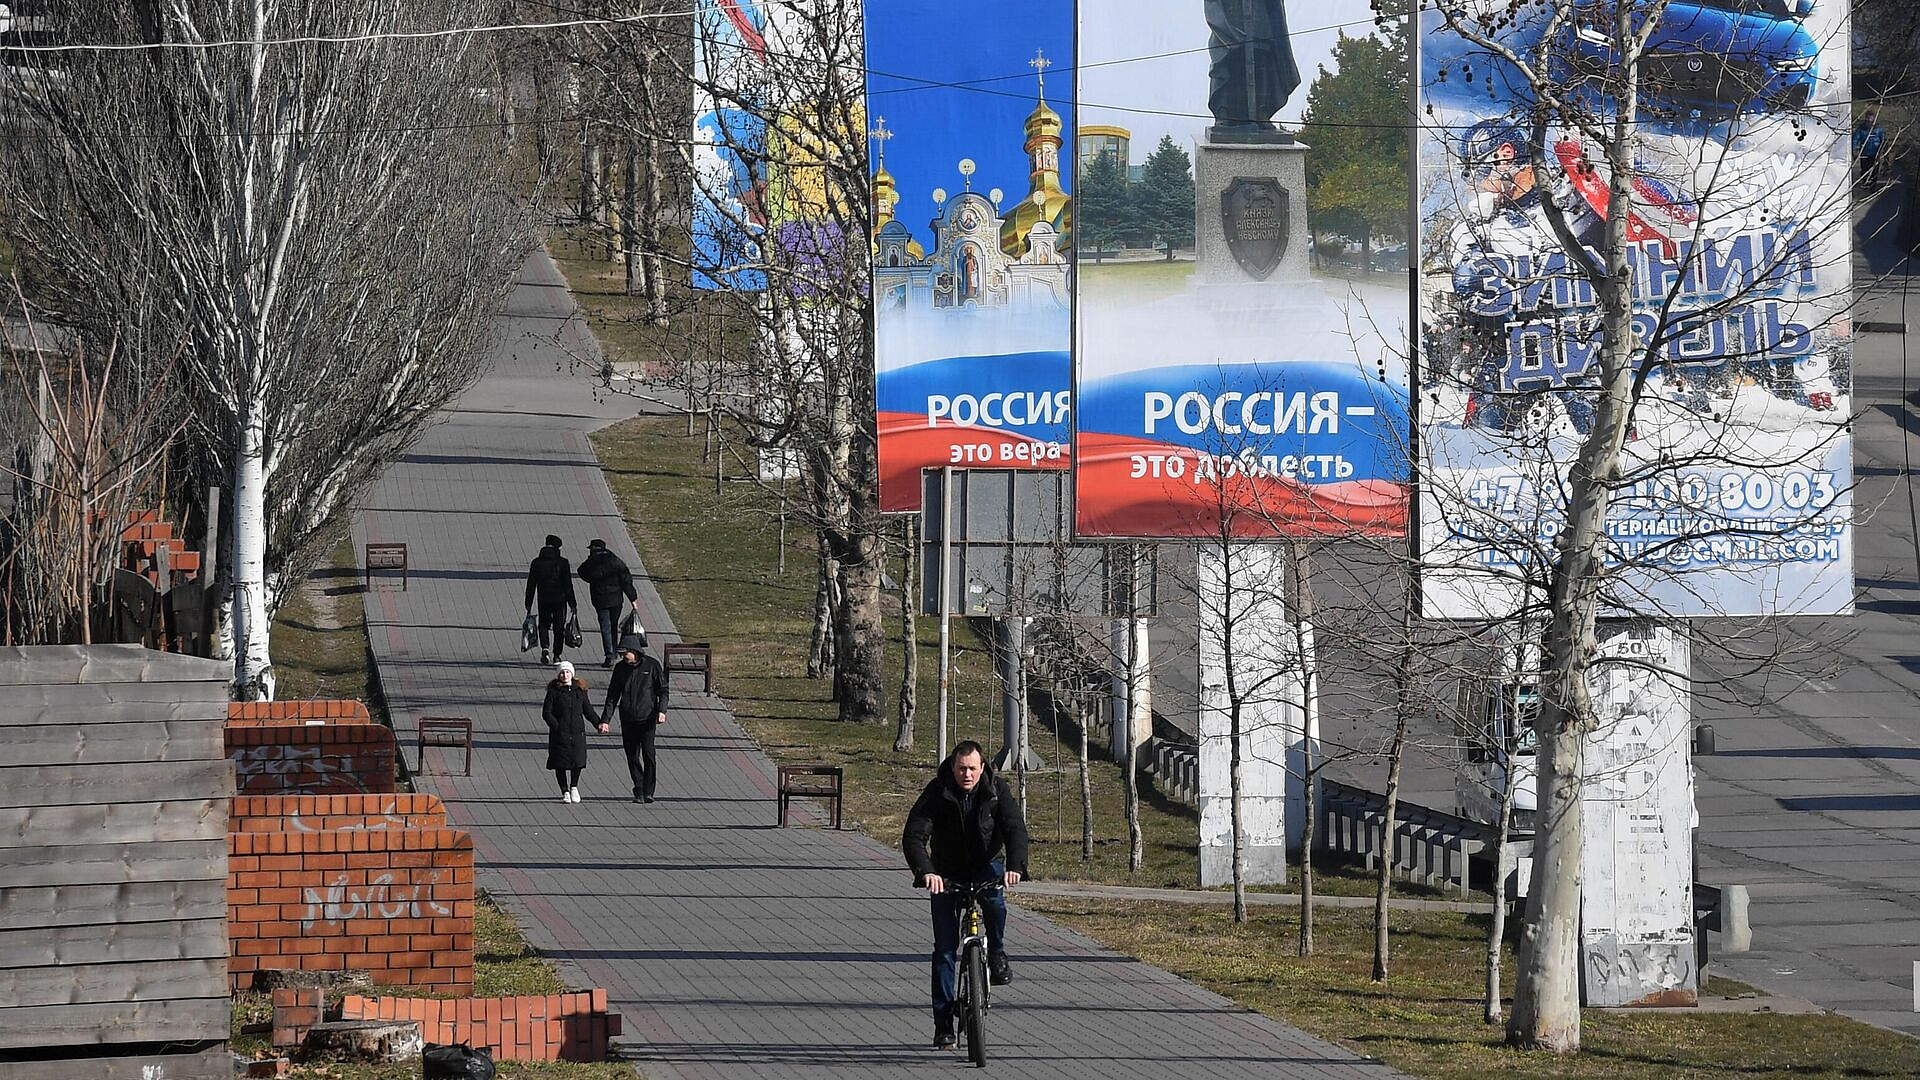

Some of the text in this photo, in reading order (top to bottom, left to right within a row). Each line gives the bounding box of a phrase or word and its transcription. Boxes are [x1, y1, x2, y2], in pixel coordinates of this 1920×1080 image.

[926, 391, 1070, 428] РОССИЯ
[949, 441, 1060, 466] это вера
[1130, 447, 1354, 484] это доблесть
[1719, 472, 1773, 509] 80
[1783, 472, 1836, 509] 03
